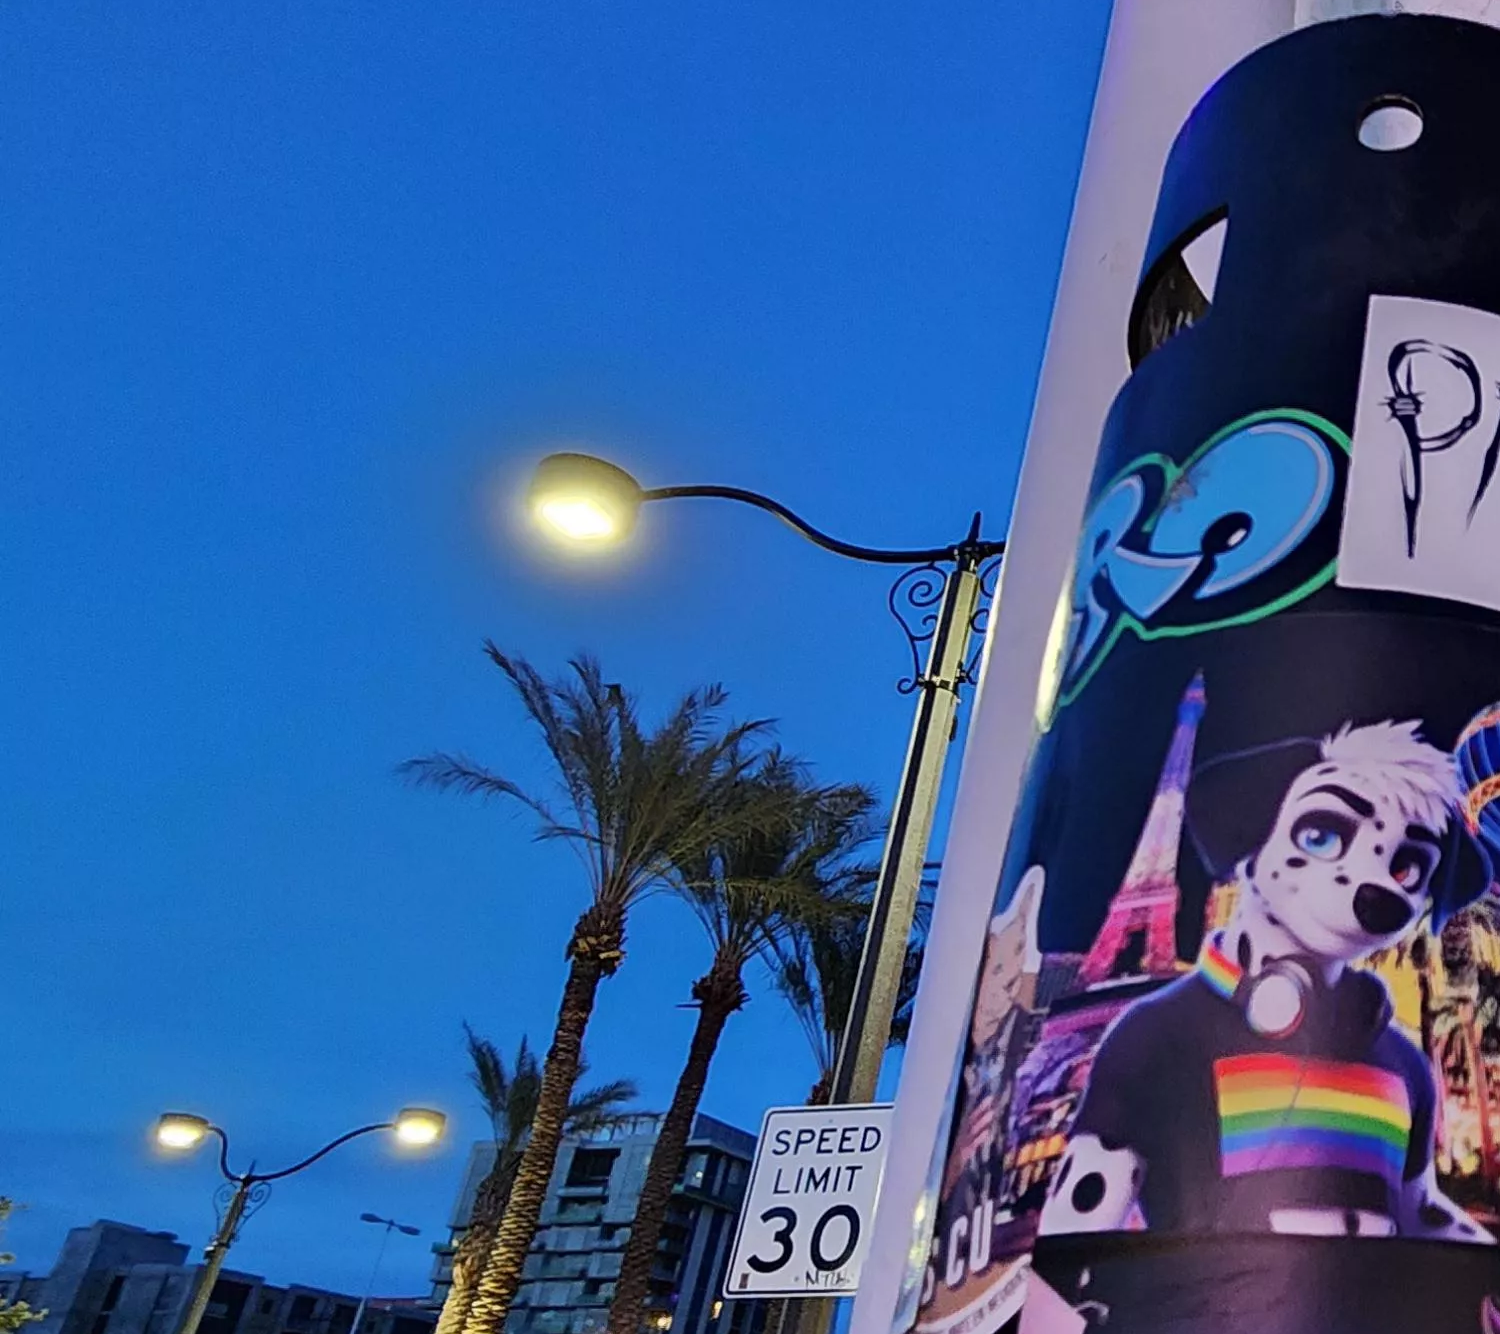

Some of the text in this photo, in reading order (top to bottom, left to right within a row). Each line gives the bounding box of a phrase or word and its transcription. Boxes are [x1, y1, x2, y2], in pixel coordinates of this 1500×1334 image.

[772, 1126, 882, 1156] SPEED
[773, 1165, 863, 1194] LIMIT
[747, 1204, 860, 1273] 30
